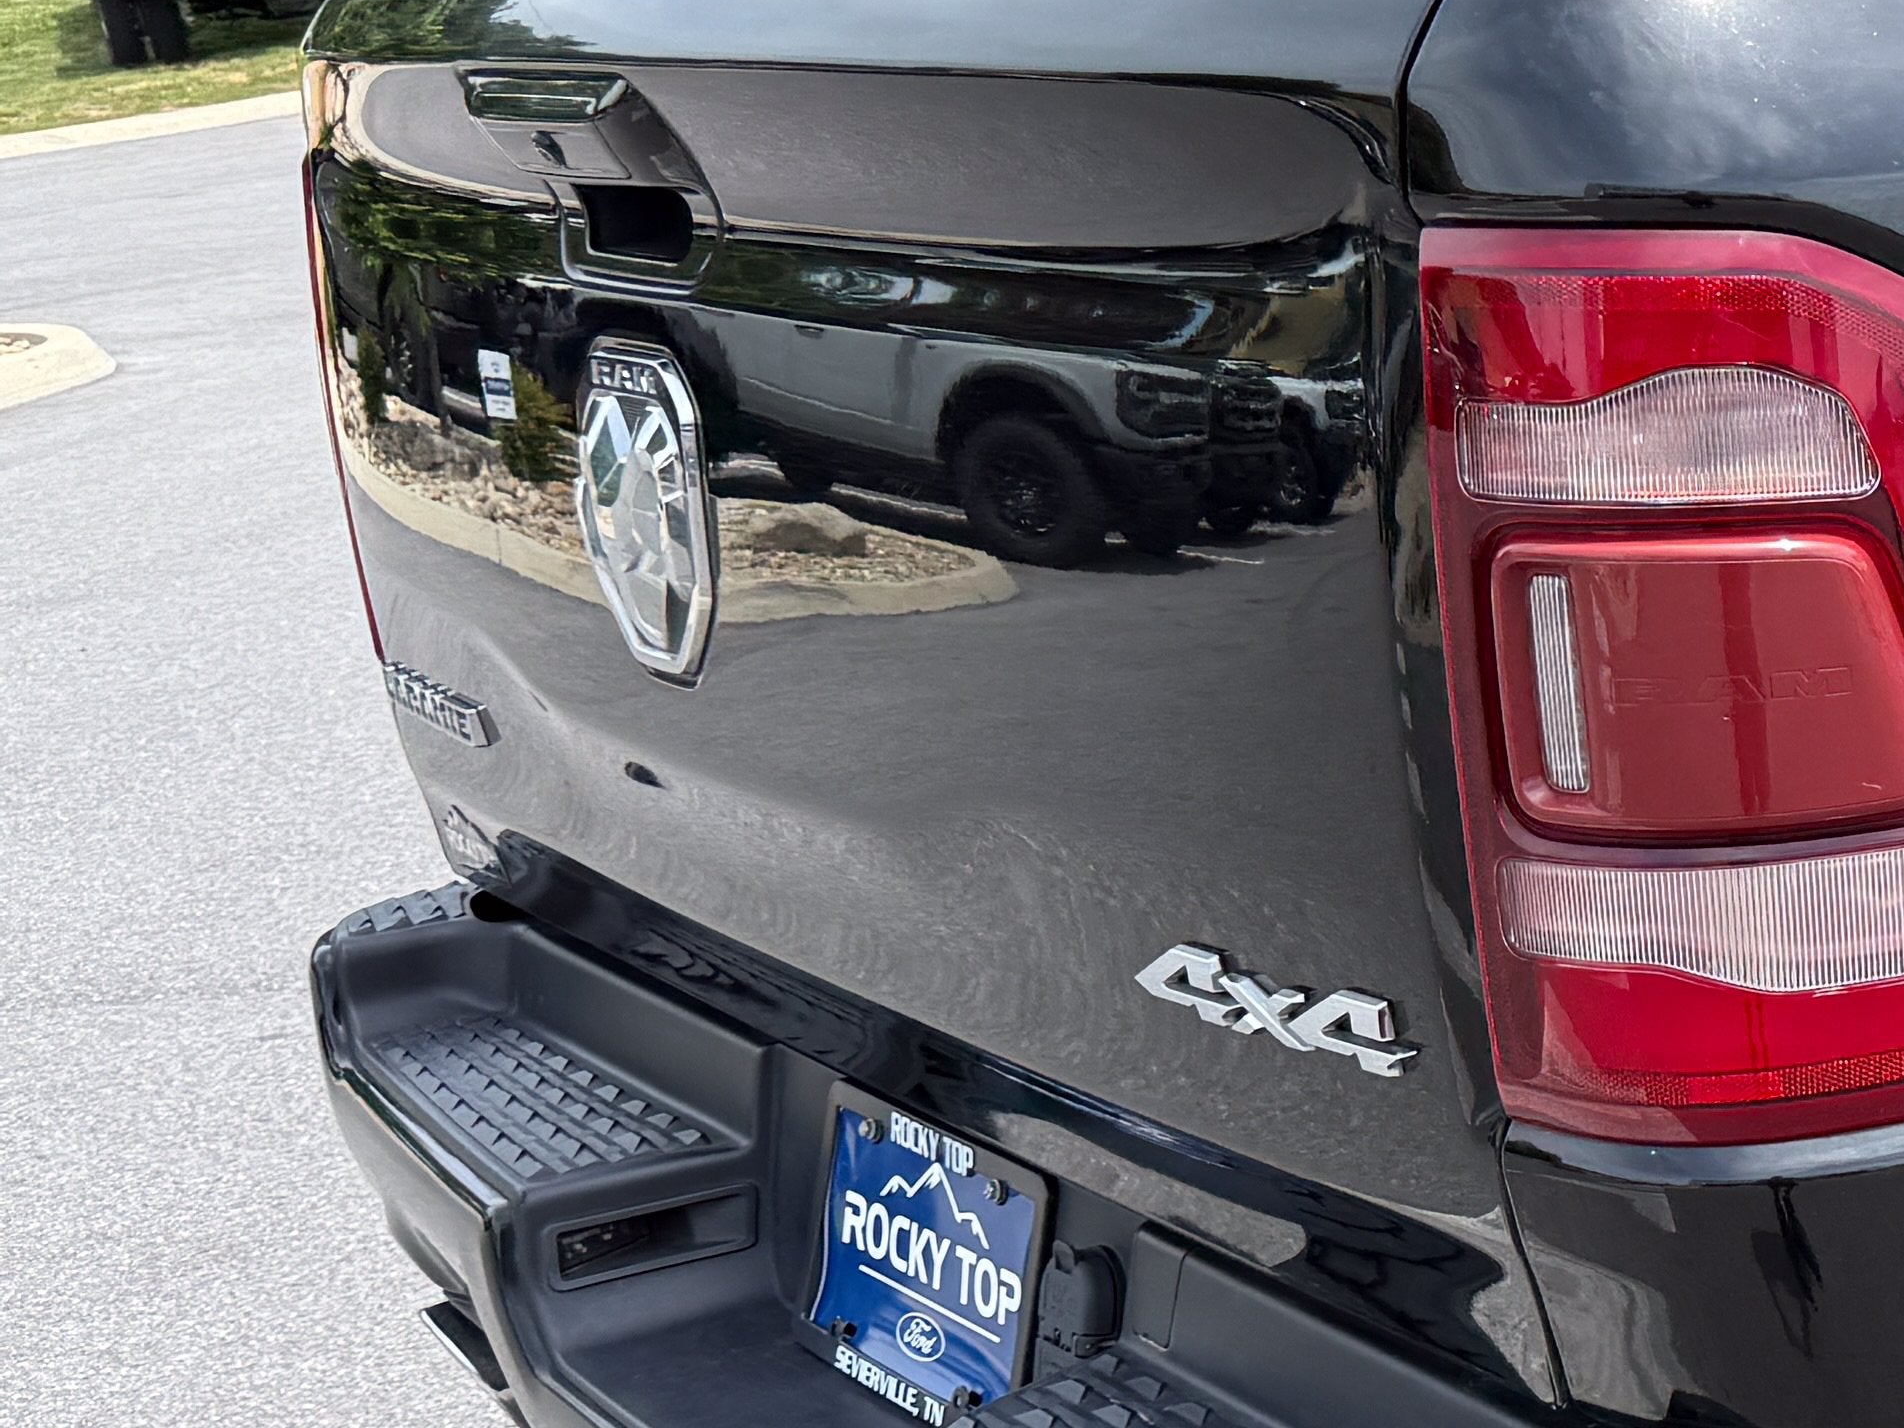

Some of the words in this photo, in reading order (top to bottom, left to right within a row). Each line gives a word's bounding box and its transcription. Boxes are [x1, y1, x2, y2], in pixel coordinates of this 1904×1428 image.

[589, 357, 658, 395] RAM
[1611, 666, 1852, 708] RAM
[890, 1110, 940, 1162] ROCKY
[942, 1135, 975, 1177] TOP
[841, 1189, 951, 1291] ROCKY
[955, 1244, 1023, 1326] TOP
[902, 1317, 938, 1356] Ford
[923, 1394, 945, 1428] TN
